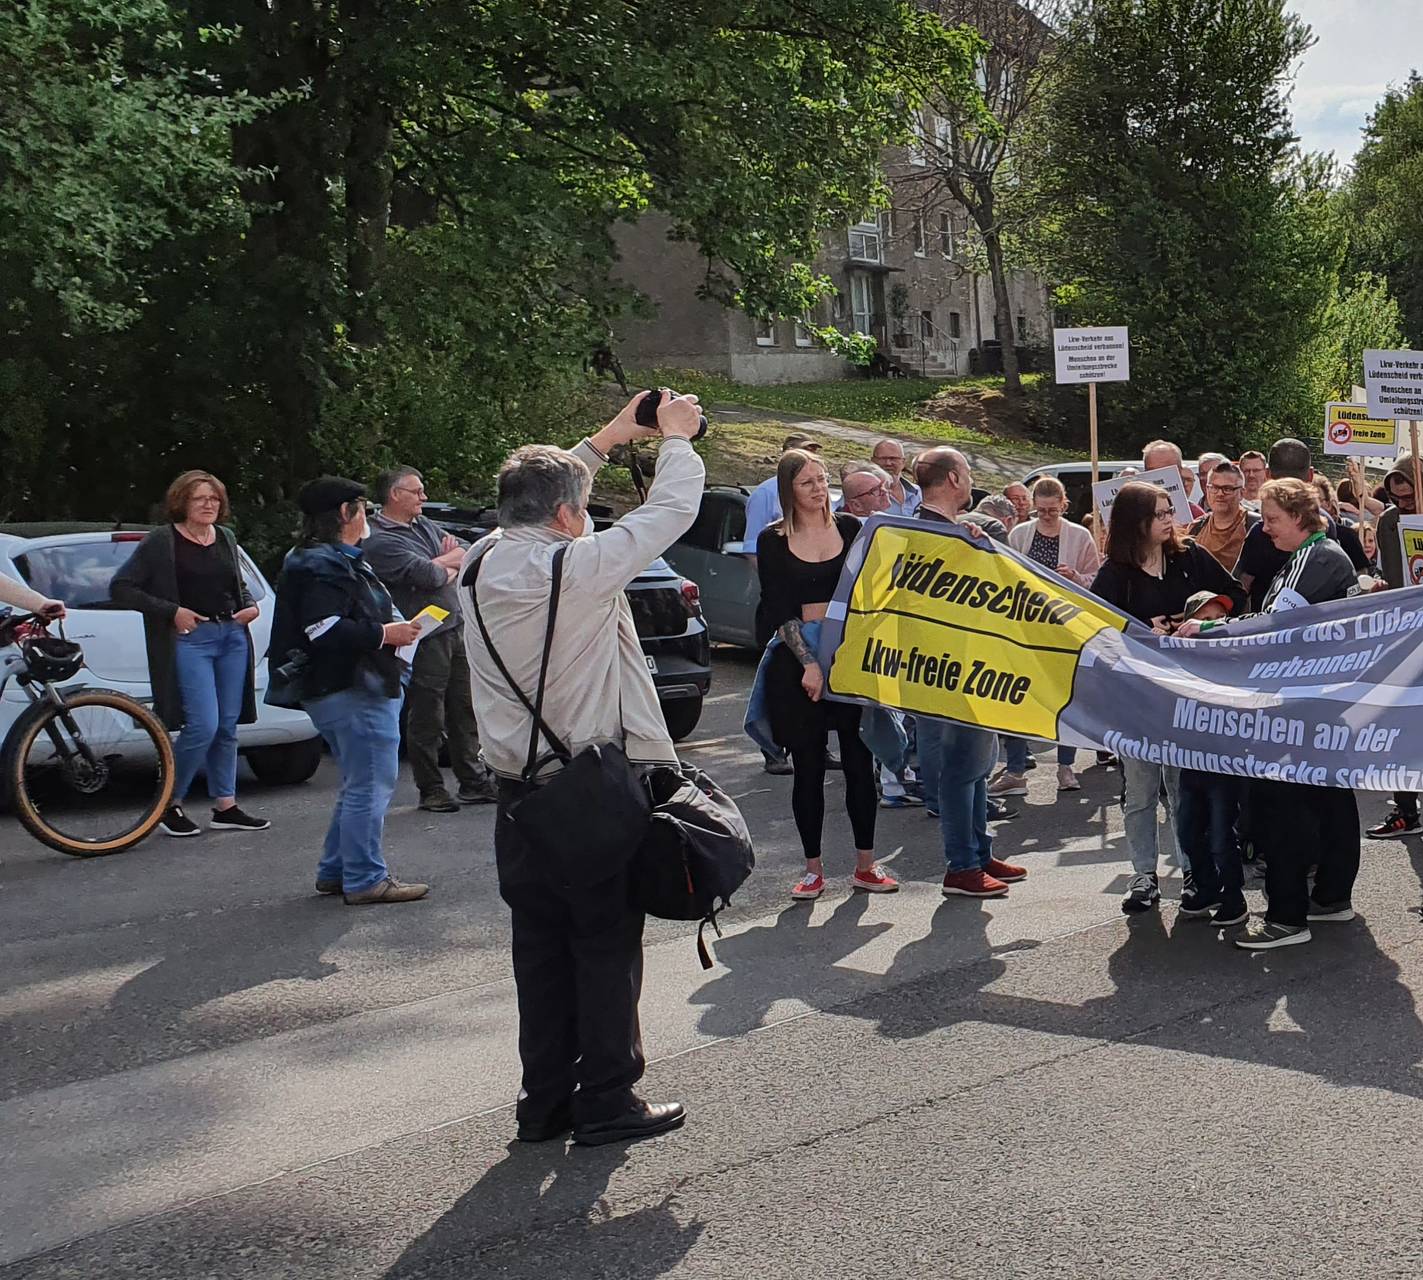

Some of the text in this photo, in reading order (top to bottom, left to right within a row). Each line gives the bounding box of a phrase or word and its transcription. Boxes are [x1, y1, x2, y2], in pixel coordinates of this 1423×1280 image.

[1380, 360, 1419, 369] Lkw-Verkehr
[1368, 370, 1409, 380] Lüdenscheid
[1380, 385, 1413, 394] Menschen
[1393, 407, 1423, 416] schützen!
[1353, 430, 1386, 439] freie Zone
[1281, 596, 1297, 609] Ord
[1301, 620, 1347, 643] aus
[1247, 642, 1385, 680] verbannen!
[861, 636, 1032, 706] Lkw-freie Zone
[1172, 697, 1401, 753] Menschen an der
[1102, 729, 1328, 787] Umleitungsstrecke
